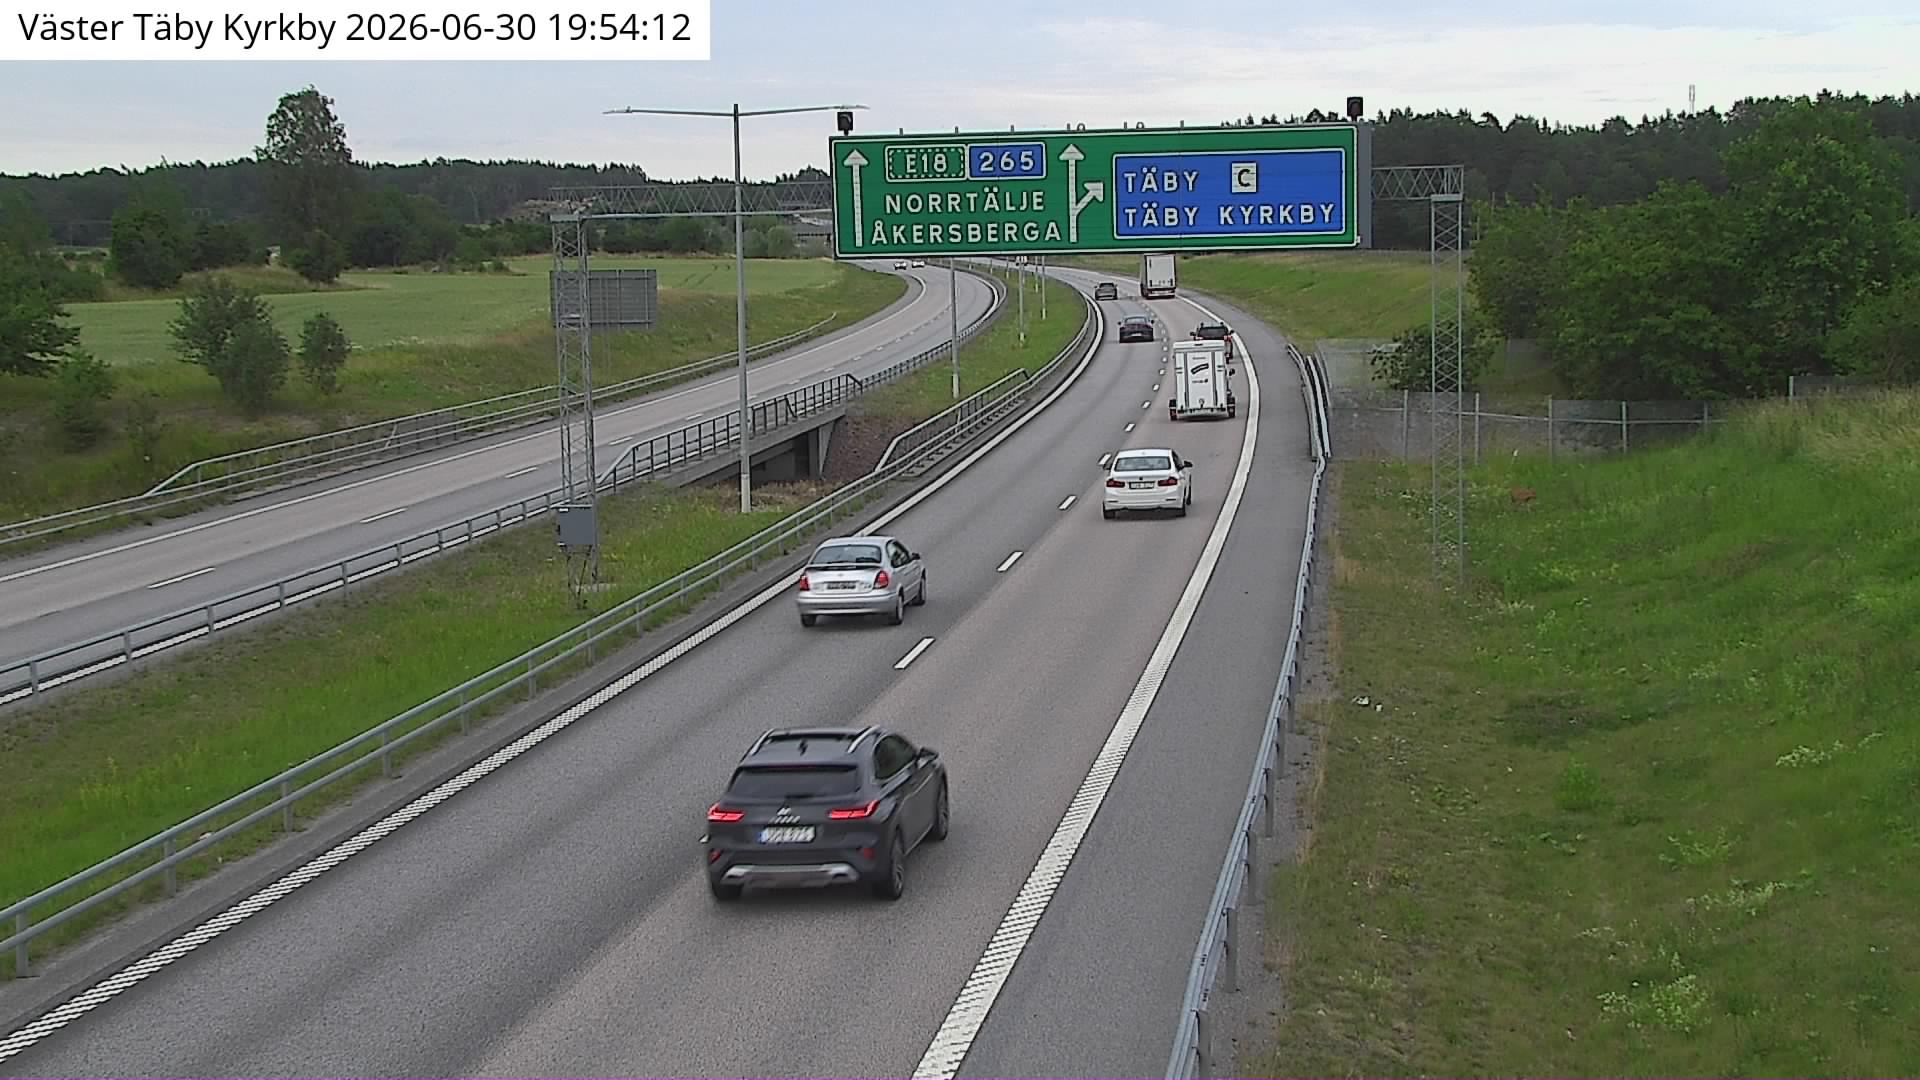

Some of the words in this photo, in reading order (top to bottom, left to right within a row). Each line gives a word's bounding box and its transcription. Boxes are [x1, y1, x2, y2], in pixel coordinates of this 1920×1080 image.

[906, 153, 947, 173] E18
[979, 150, 1035, 172] 265
[1123, 166, 1198, 192] TÄBY
[1236, 168, 1251, 188] C
[886, 186, 1045, 213] NORRTÄLJE
[1124, 202, 1199, 227] TÄBY
[1219, 203, 1335, 226] KYRKBY
[871, 219, 1061, 245] ÅKERSBERGA
